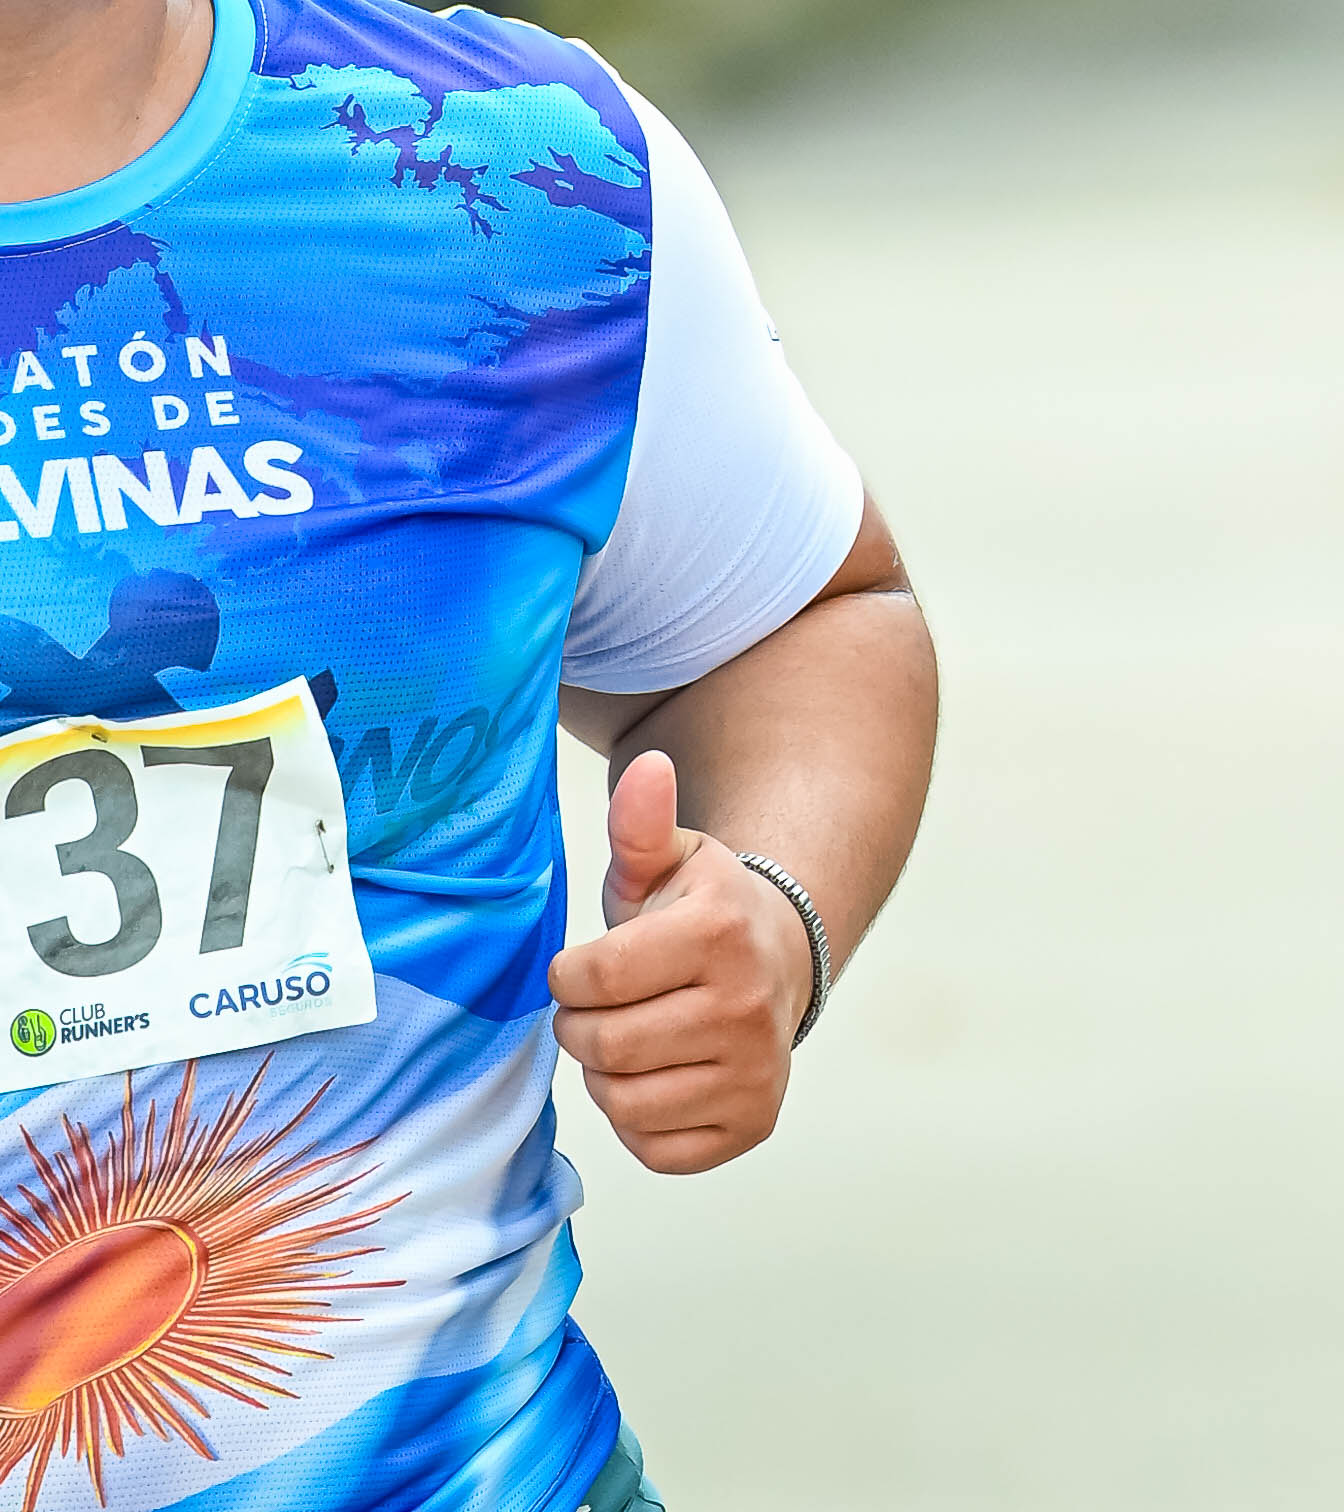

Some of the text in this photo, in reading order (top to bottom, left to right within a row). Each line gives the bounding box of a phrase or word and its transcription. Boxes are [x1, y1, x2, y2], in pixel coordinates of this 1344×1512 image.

[152, 391, 240, 430] DE
[189, 971, 331, 1019] CARUSO
[60, 1003, 106, 1026] CLUB
[61, 1012, 151, 1044] RUNNER'S
